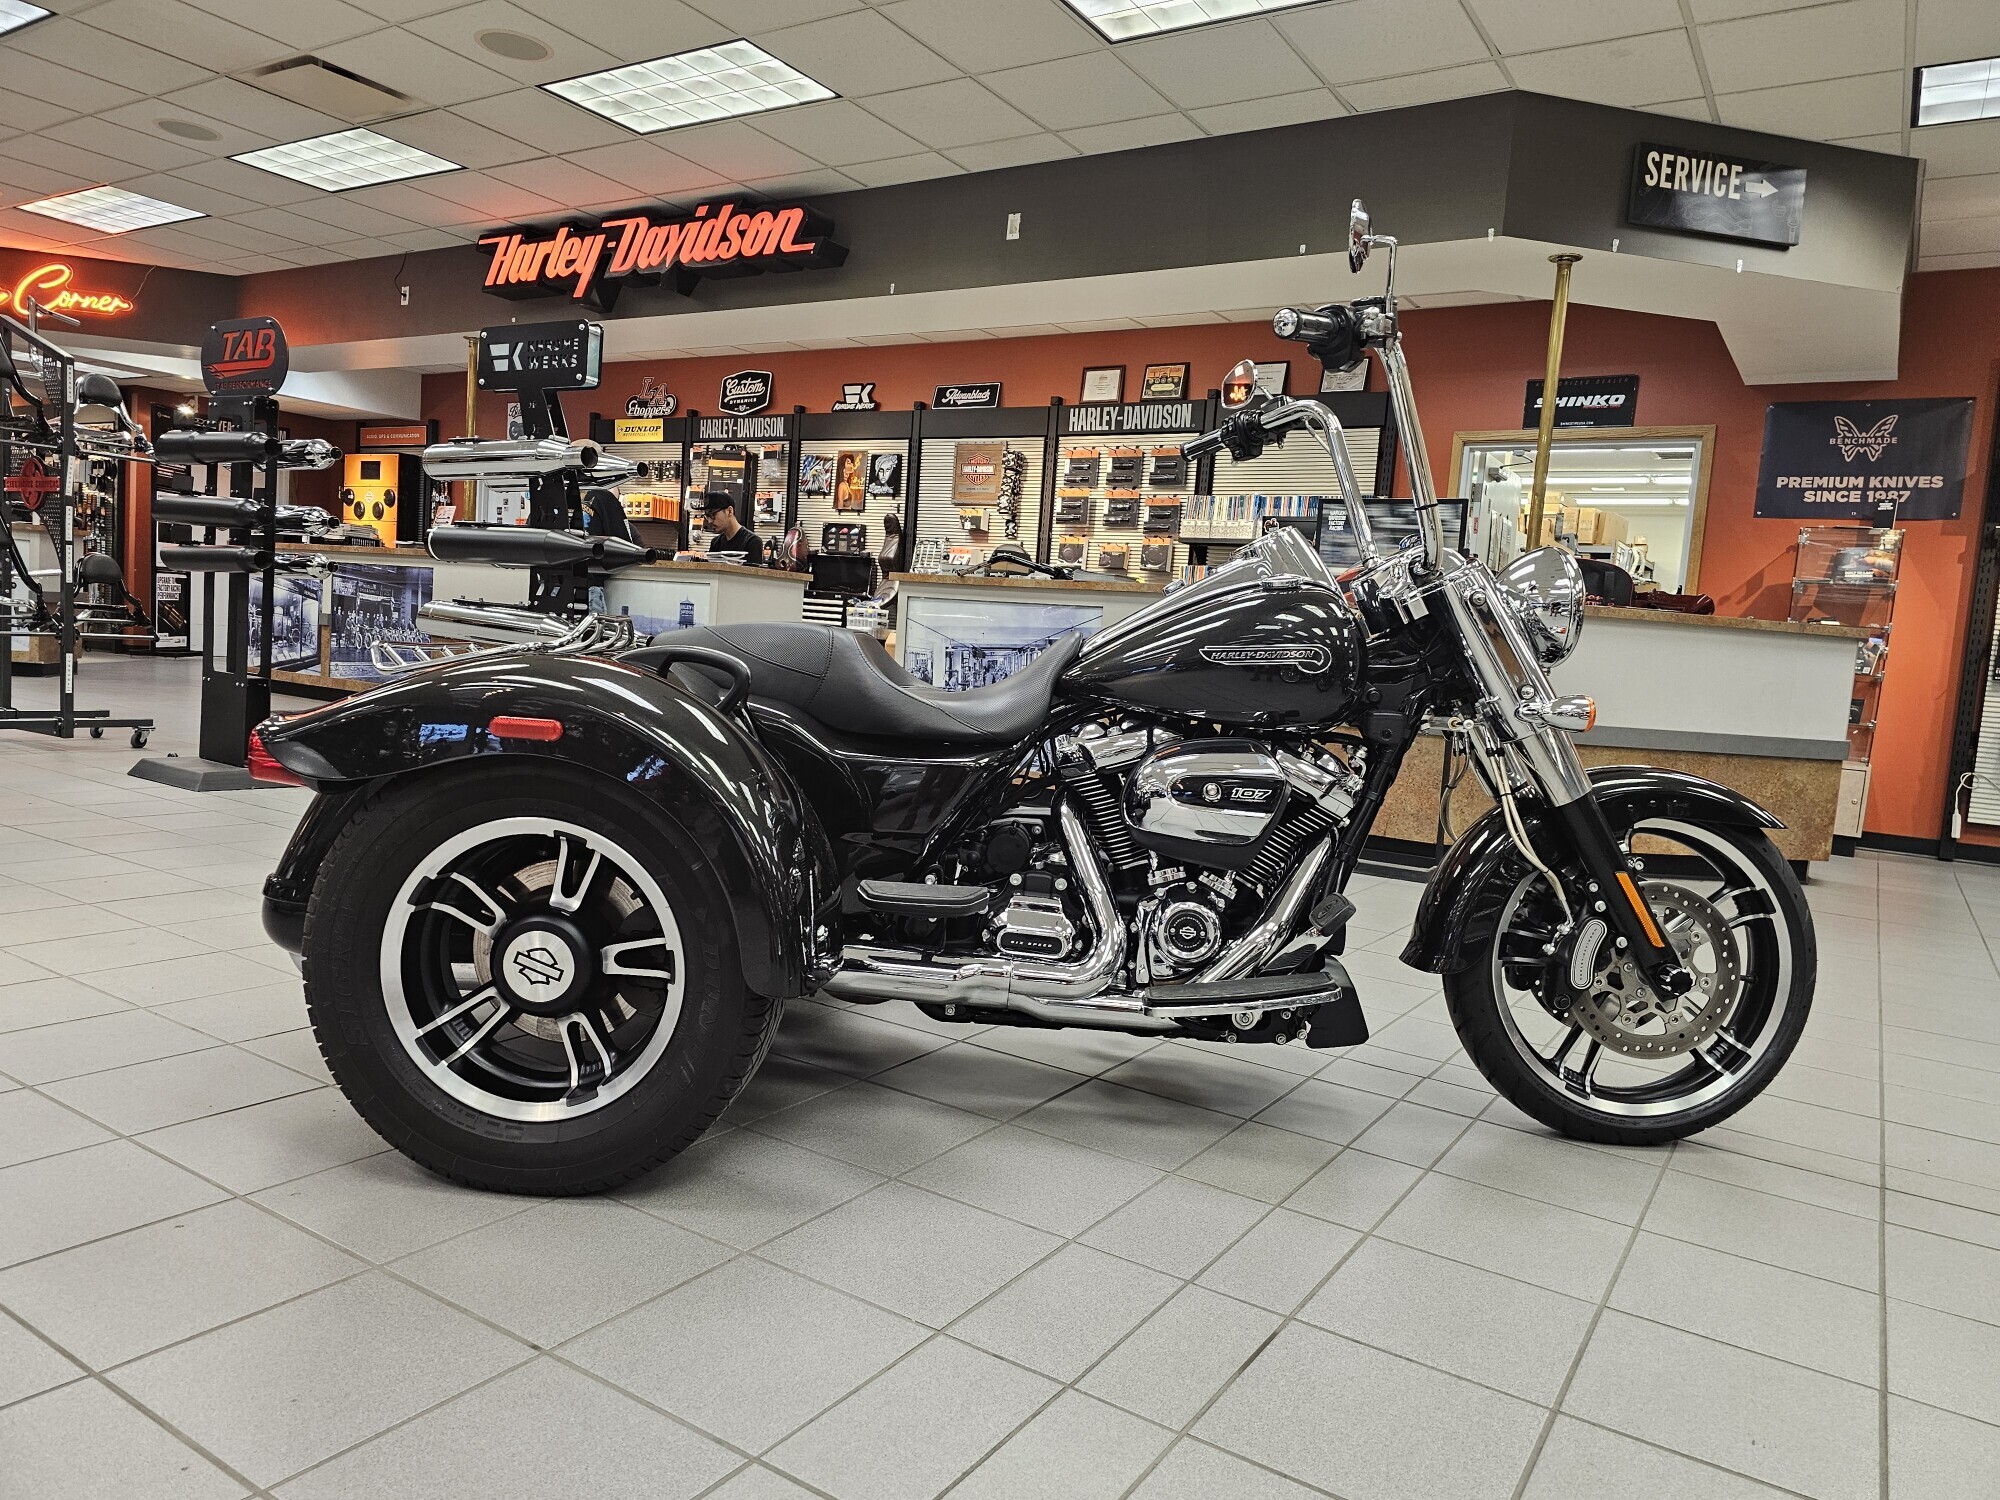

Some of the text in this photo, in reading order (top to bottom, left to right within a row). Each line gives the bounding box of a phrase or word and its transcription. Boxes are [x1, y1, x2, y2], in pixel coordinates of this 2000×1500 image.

[1645, 151, 1743, 200] SERVICE
[479, 203, 816, 298] Harley-Davidson
[13, 264, 130, 317] Corner
[222, 328, 276, 361] TAB
[527, 338, 579, 353] KHROME
[528, 354, 578, 369] WERKS
[229, 380, 272, 390] PERFORMANCE
[639, 377, 667, 407] LA
[724, 377, 766, 398] Custom
[941, 388, 991, 405] Advanblack
[1069, 404, 1192, 431] HARLEY-DAVIDSON
[700, 417, 784, 439] HARLEY-DAVIDSON
[1829, 437, 1898, 445] BENCHMADE
[1776, 476, 1944, 488] PREMIUM KNIVES
[1803, 491, 1911, 503] SINCE 1987
[1211, 651, 1315, 660] HARLEY-DAVIDSON
[1231, 788, 1272, 799] 107
